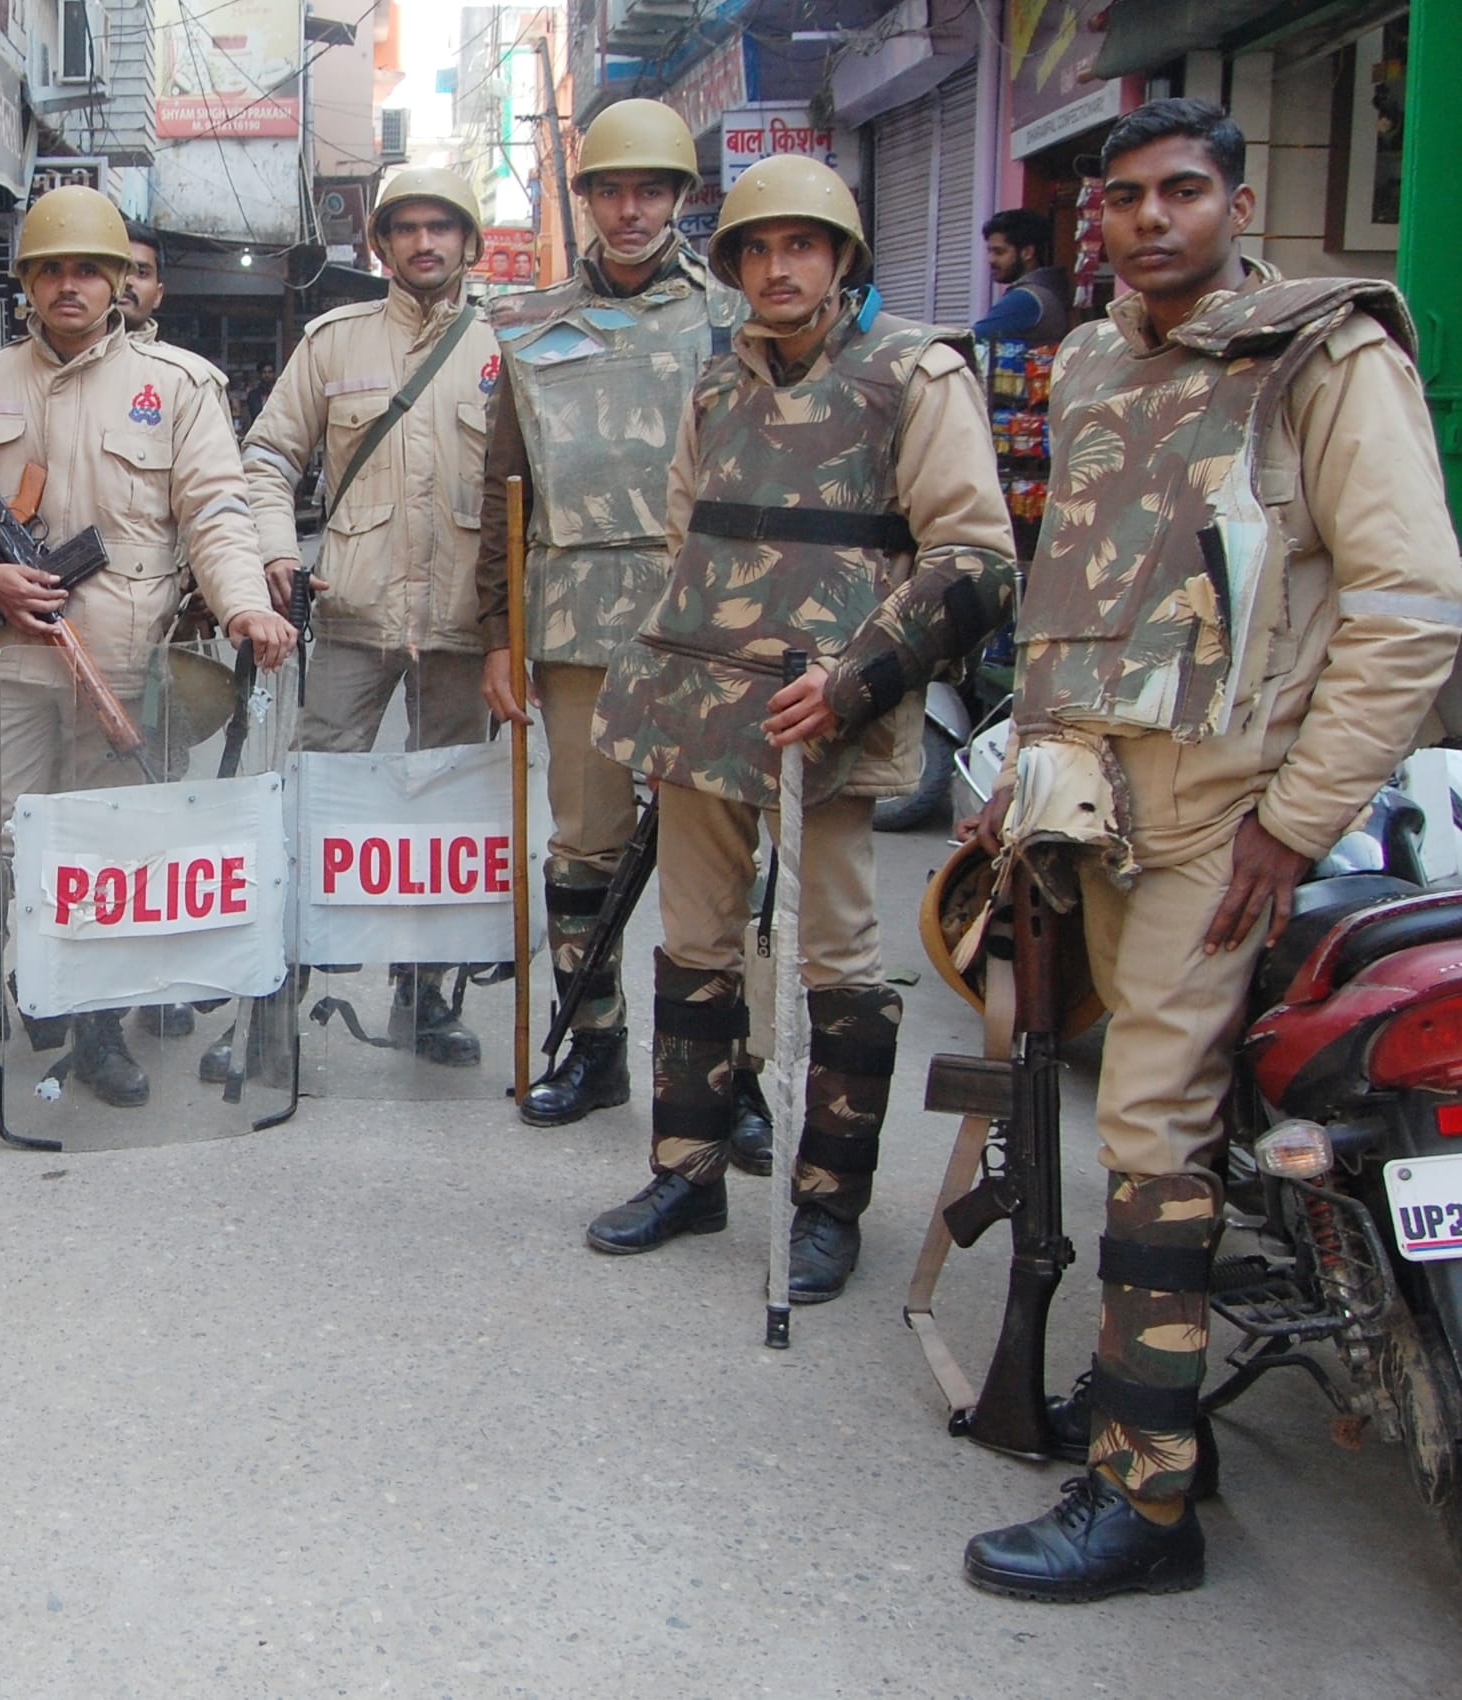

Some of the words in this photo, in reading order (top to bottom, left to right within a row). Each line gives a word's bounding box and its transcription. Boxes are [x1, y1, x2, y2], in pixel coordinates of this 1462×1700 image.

[162, 107, 194, 120] SHYAM
[726, 129, 765, 153] बाल
[769, 117, 835, 153] किशन
[322, 836, 510, 895] POLICE
[55, 856, 247, 926] POLICE
